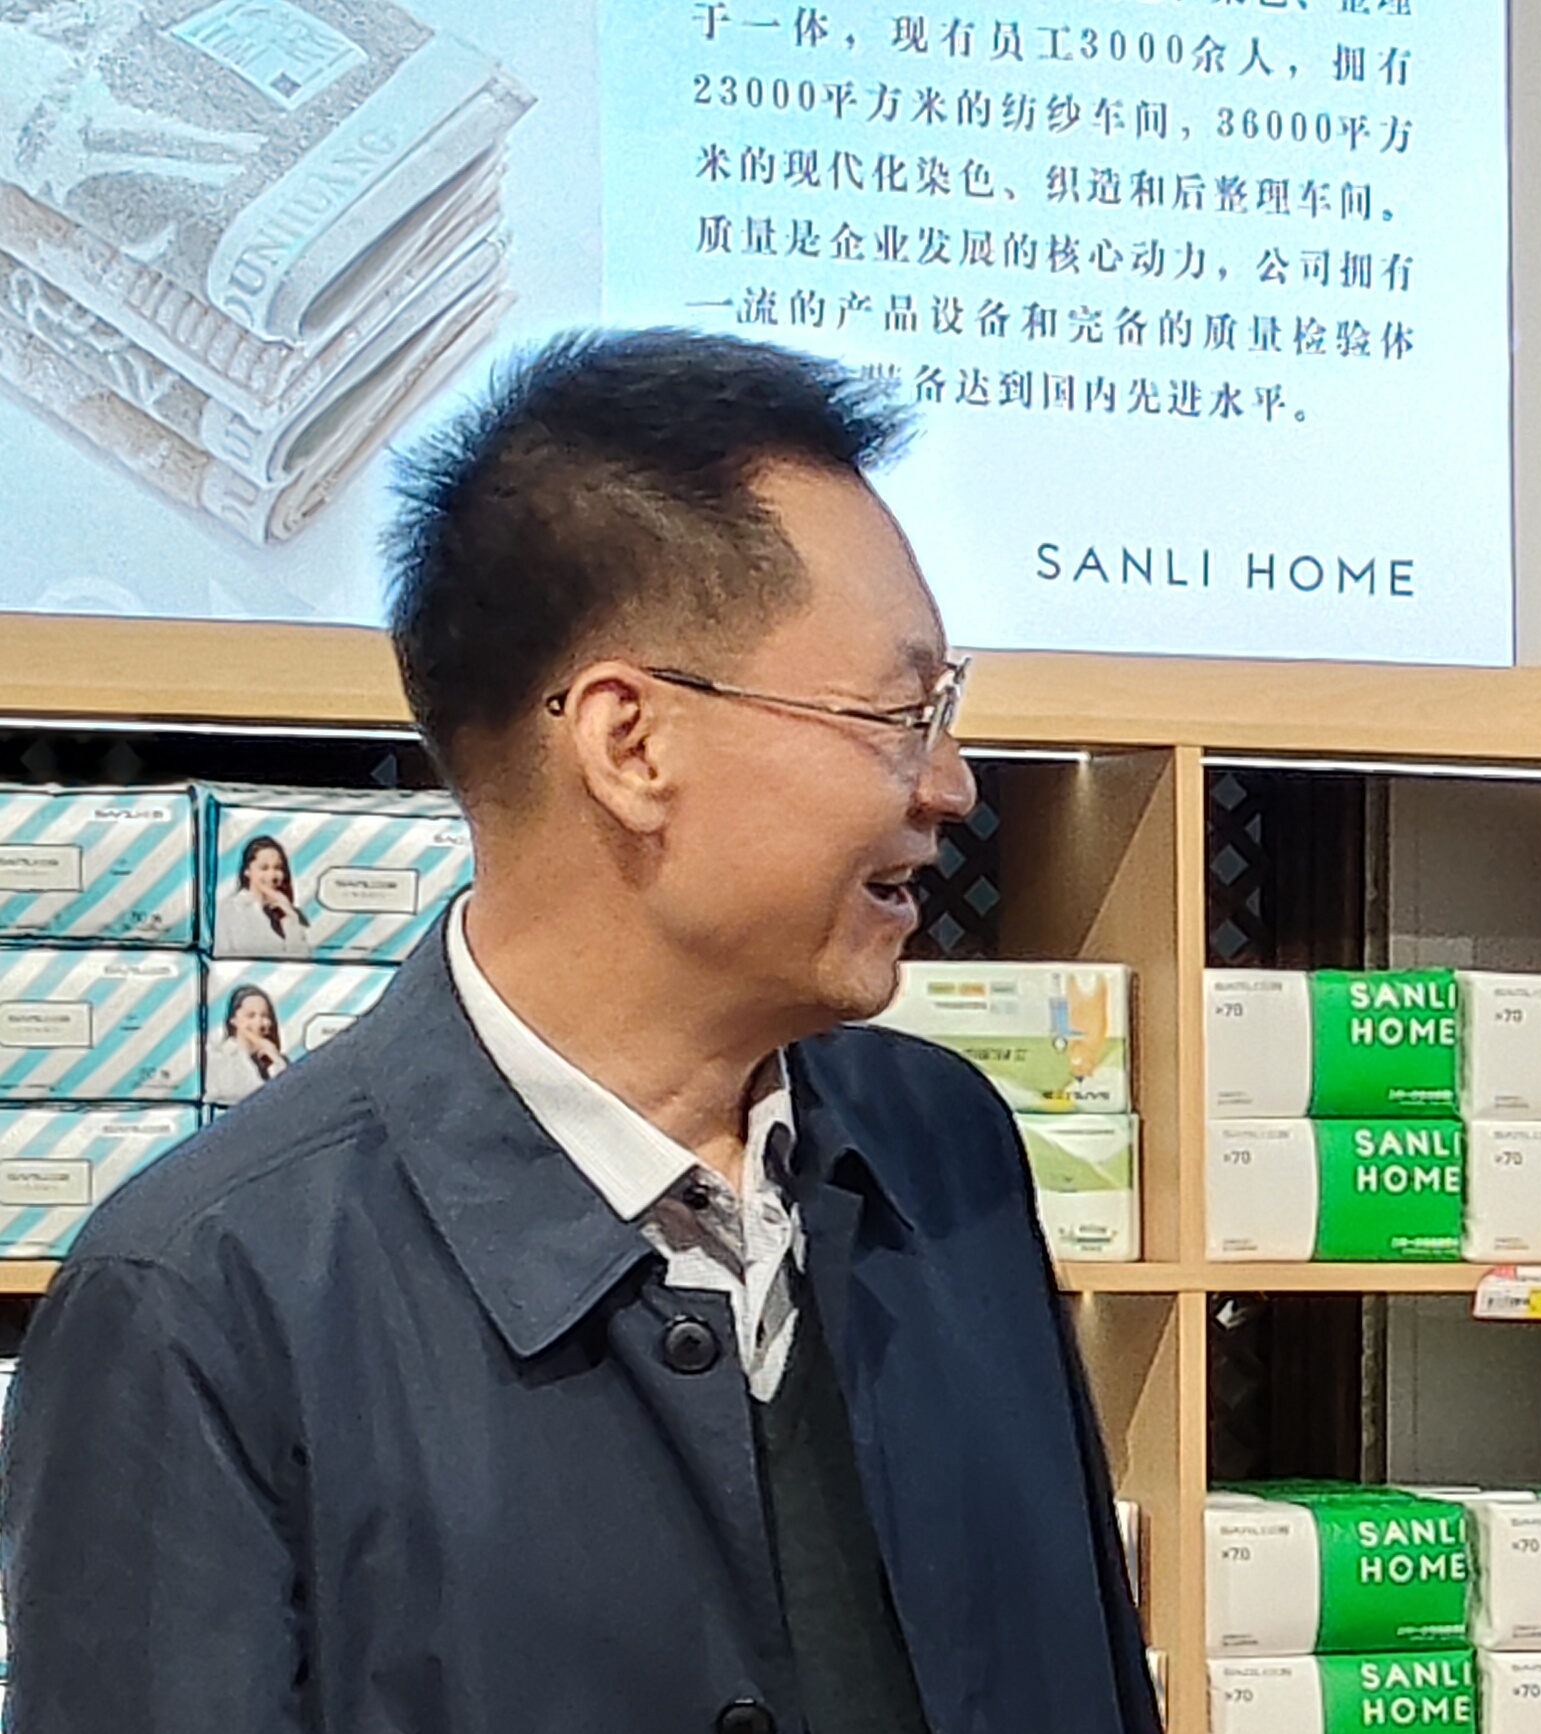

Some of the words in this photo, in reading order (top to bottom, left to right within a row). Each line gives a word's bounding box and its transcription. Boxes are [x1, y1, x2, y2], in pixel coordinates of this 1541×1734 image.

[691, 2, 1412, 85] 于一体，现有员工3000余人，拥有
[693, 73, 1413, 153] 23000平方米的纺纱车间，36000平方
[695, 143, 1395, 222] 米的现代化染色、织造和后整理车间。
[695, 214, 1414, 292] 质量是企业发展的核心动力，公司拥有
[684, 285, 1414, 360] 一流的产品设备和完备的质量检验体
[1036, 542, 1210, 588] SANLI
[1247, 552, 1415, 597] HOME
[1350, 981, 1456, 1010] SANLI
[1350, 1017, 1456, 1045] HOME
[1354, 1129, 1463, 1157] SANLI
[1356, 1165, 1461, 1194] HOME
[1358, 1517, 1466, 1548] SANLI
[1360, 1554, 1466, 1584] HOME
[1361, 1661, 1472, 1690] SANLI
[1363, 1697, 1471, 1725] HOME
